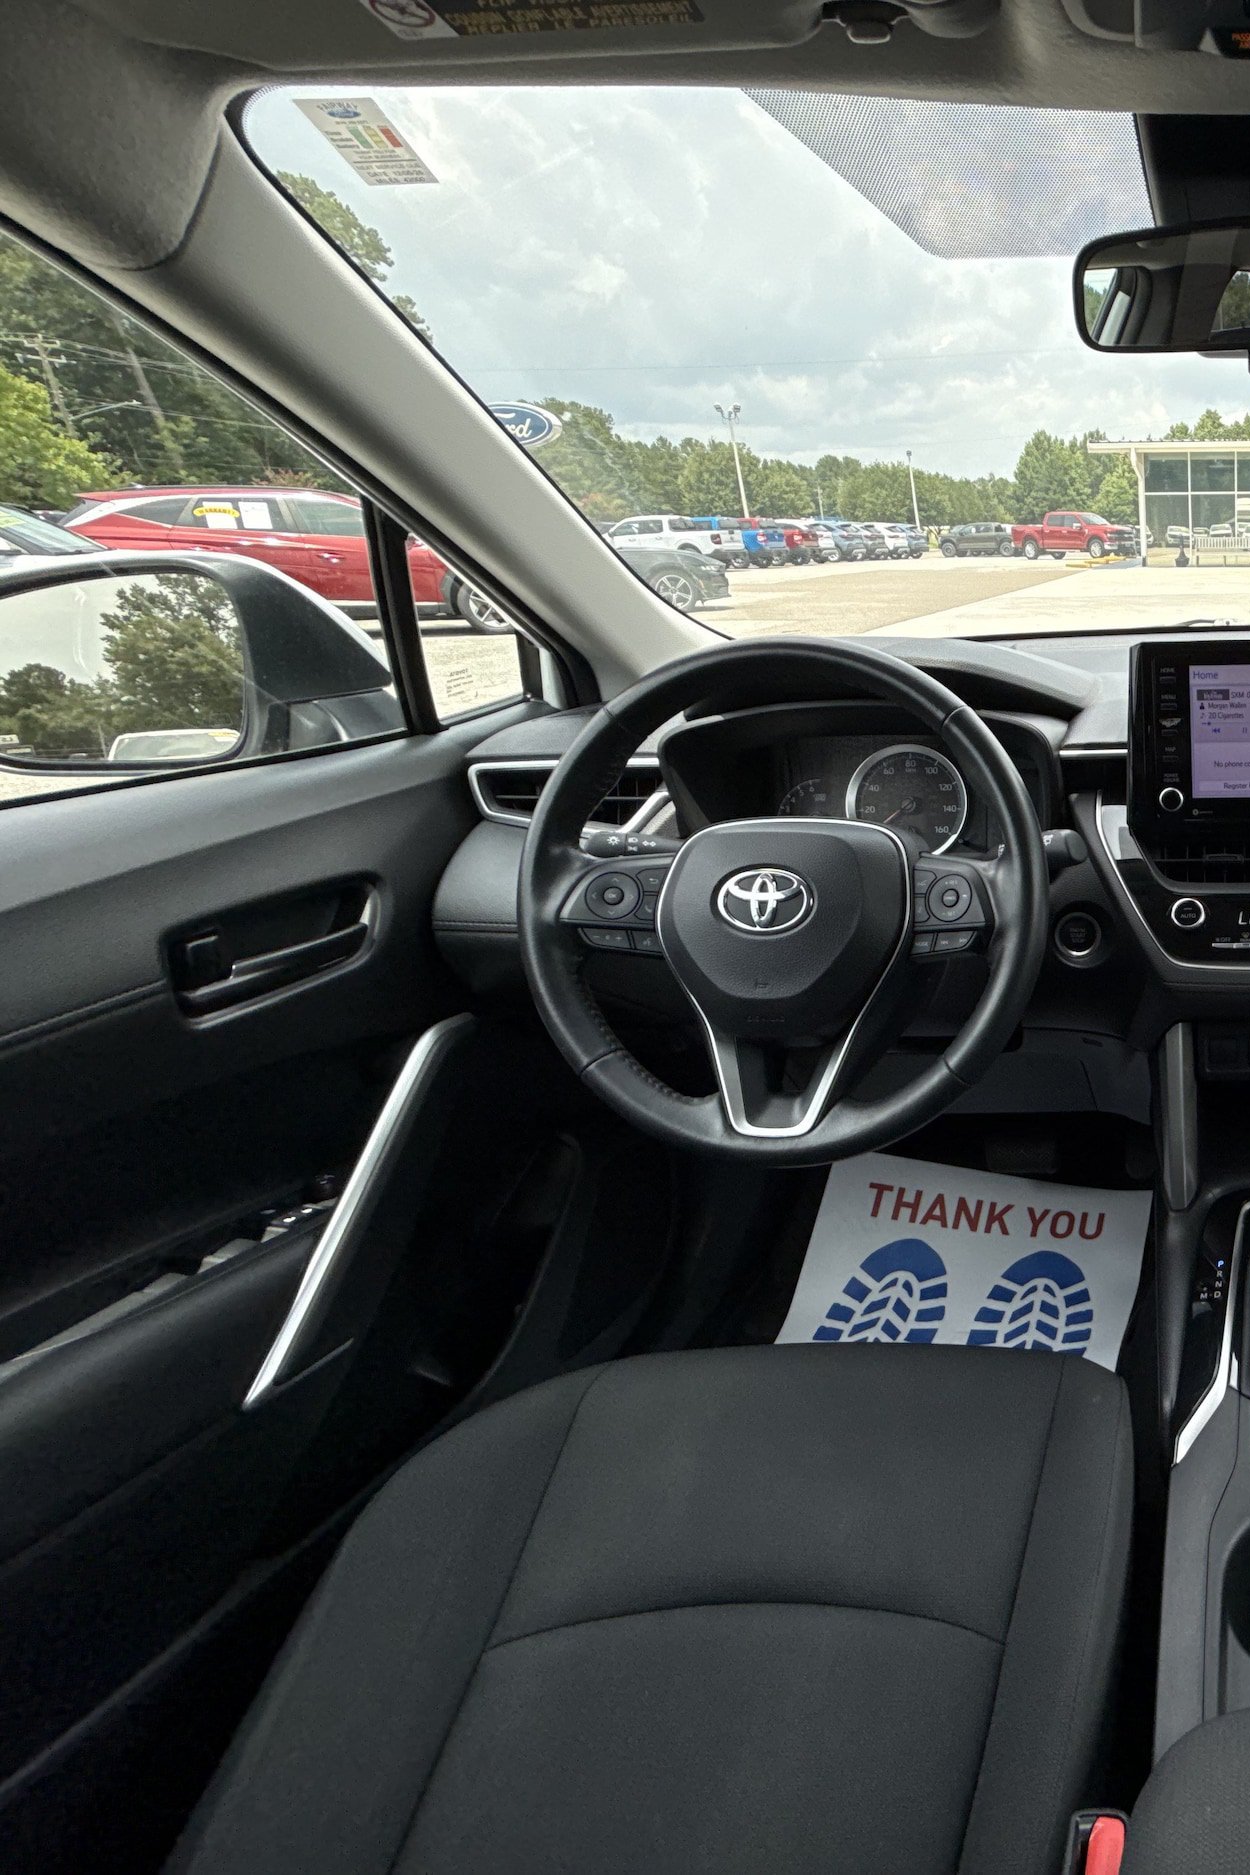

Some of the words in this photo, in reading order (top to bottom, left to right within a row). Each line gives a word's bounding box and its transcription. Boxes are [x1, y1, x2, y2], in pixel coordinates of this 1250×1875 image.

[1192, 671, 1219, 680] Home
[1230, 691, 1245, 699] SXM
[1208, 702, 1229, 710] Morgan
[1217, 712, 1245, 720] Cigarettes
[905, 759, 916, 767] 80
[1213, 760, 1223, 768] No
[1224, 760, 1244, 769] phone
[883, 767, 895, 775] 60
[924, 766, 938, 775] 100
[869, 784, 880, 792] 40
[938, 783, 952, 791] 120
[1223, 782, 1248, 790] Register
[864, 805, 876, 814] 20
[942, 805, 957, 813] 140
[934, 825, 949, 834] 160
[869, 1182, 1015, 1236] THANK
[1027, 1206, 1105, 1240] YOU
[1217, 1260, 1225, 1268] P
[1216, 1270, 1223, 1278] R
[1214, 1280, 1223, 1288] N
[1199, 1292, 1208, 1300] M
[1213, 1290, 1222, 1299] D
